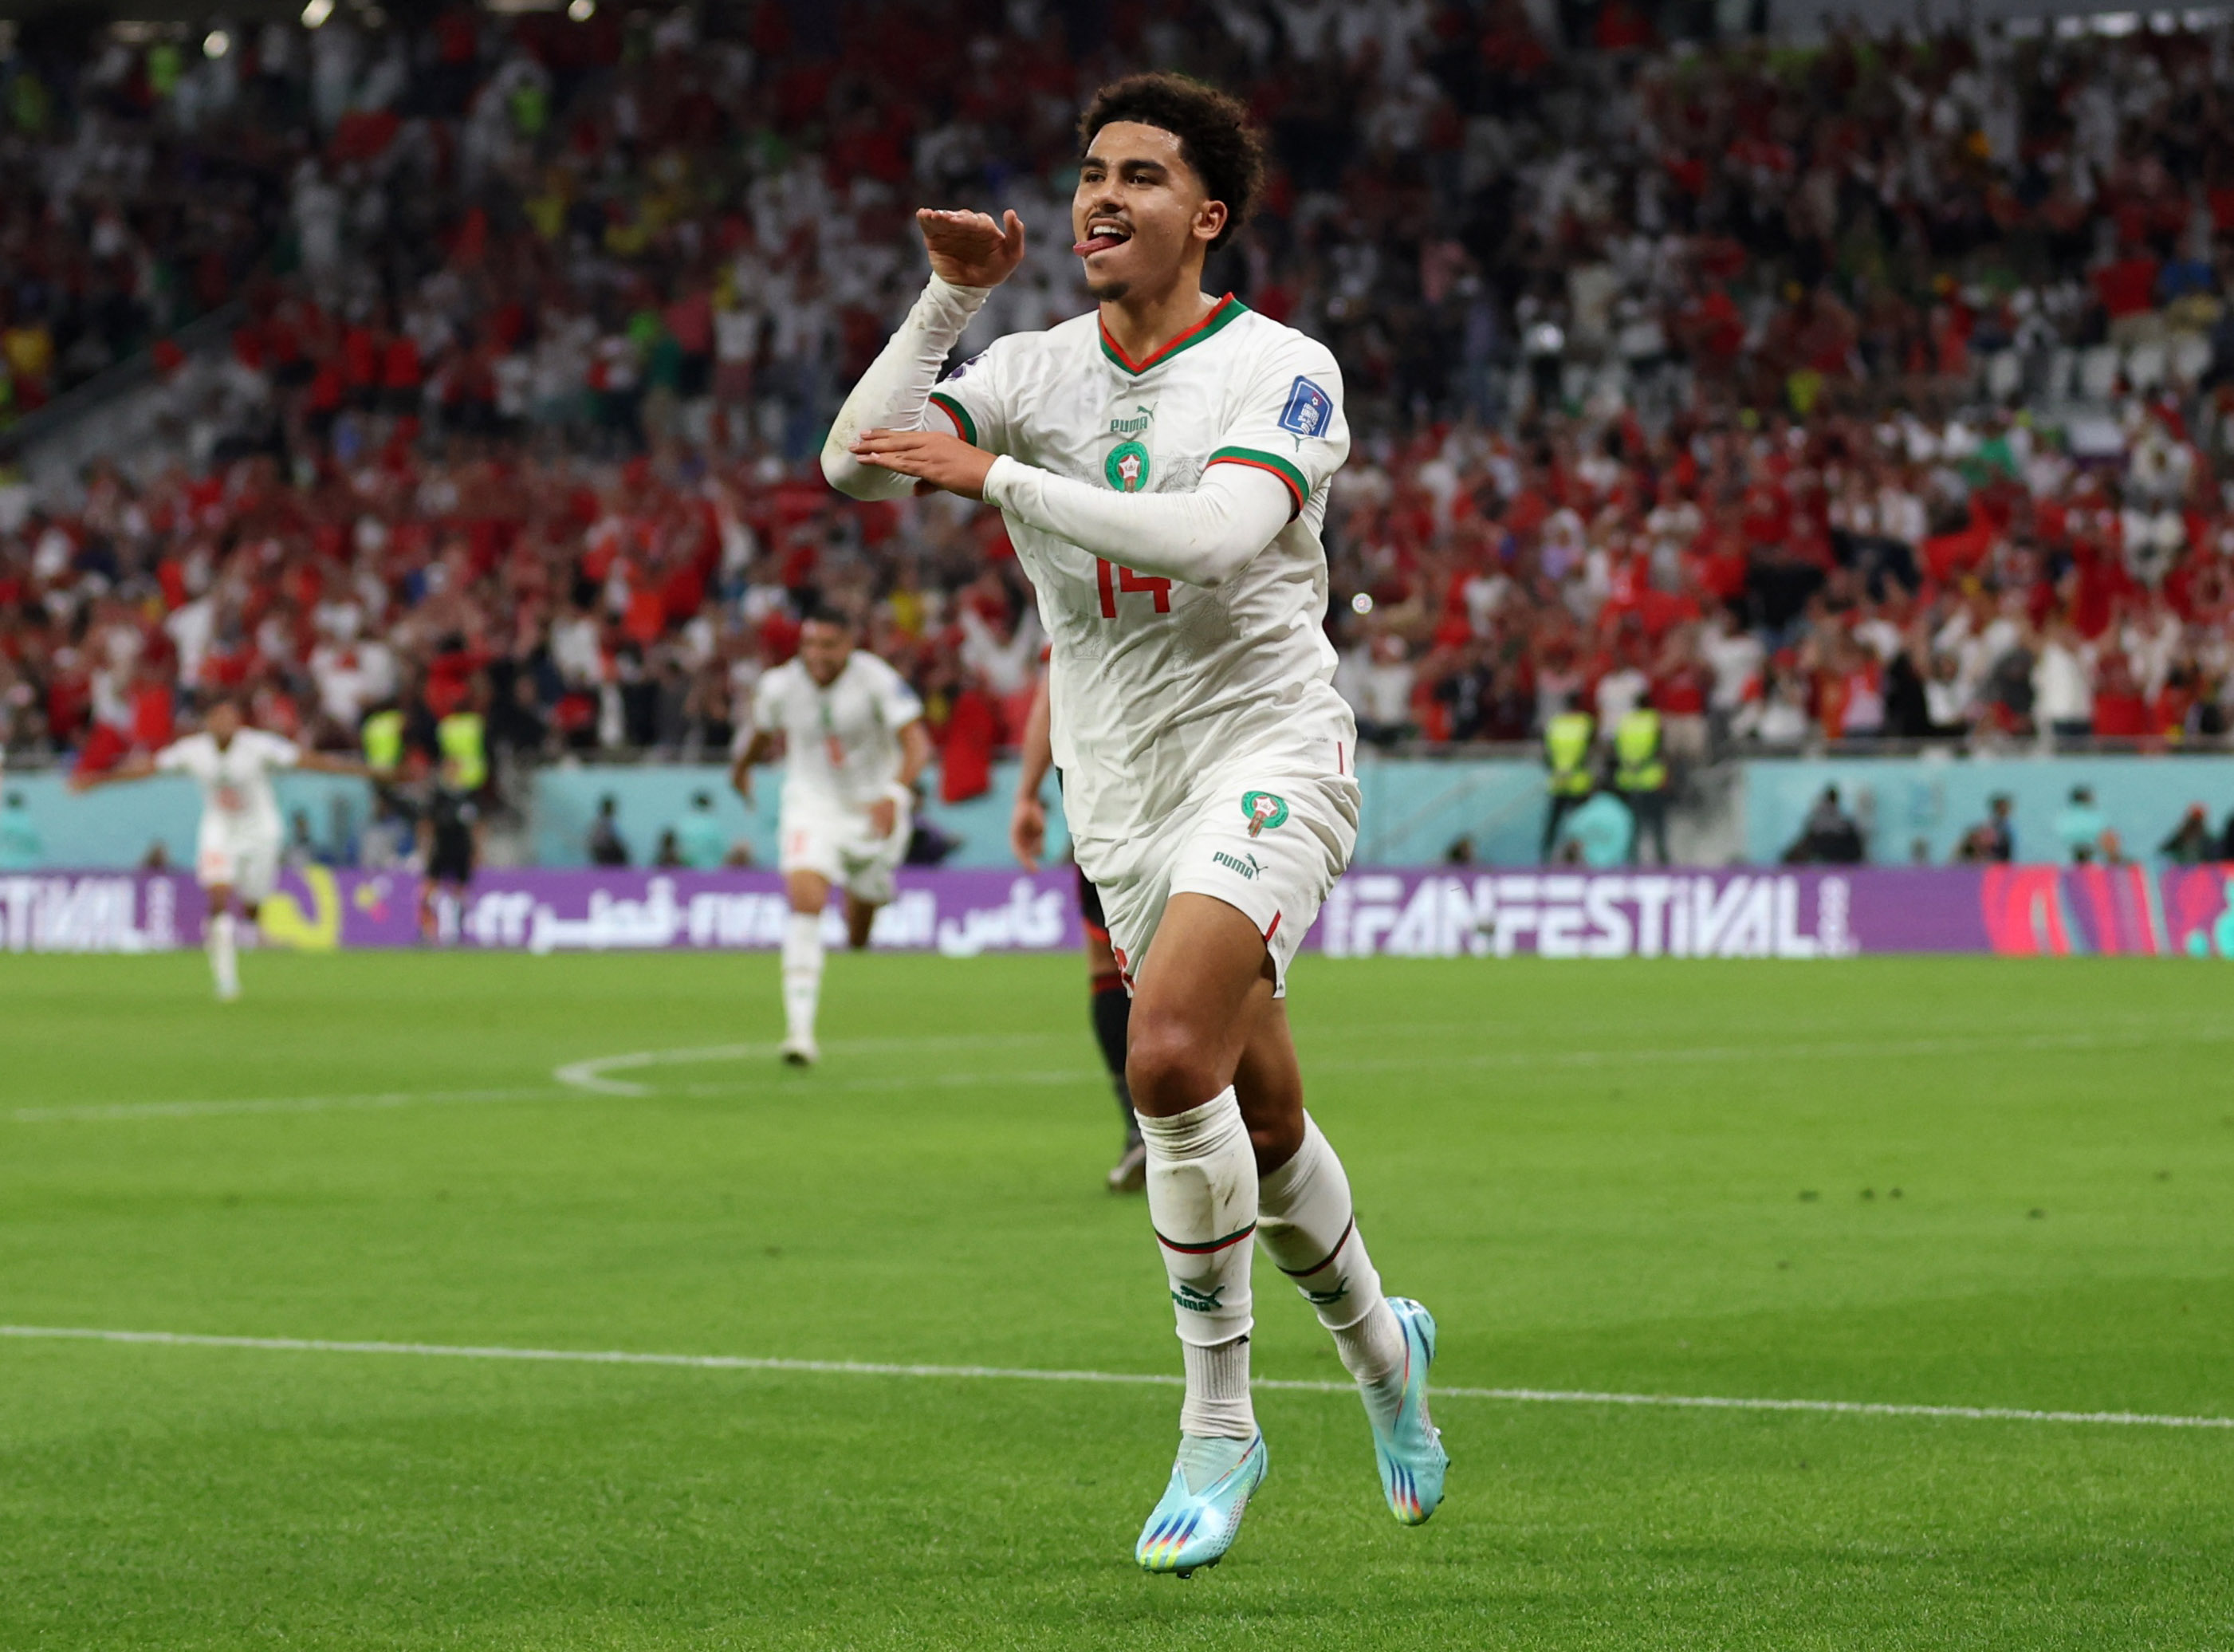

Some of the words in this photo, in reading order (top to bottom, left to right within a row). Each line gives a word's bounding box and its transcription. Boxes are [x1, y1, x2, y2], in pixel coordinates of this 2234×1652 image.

[1110, 416, 1147, 433] PUMA
[1096, 557, 1171, 618] 14
[1213, 852, 1253, 880] PUMA
